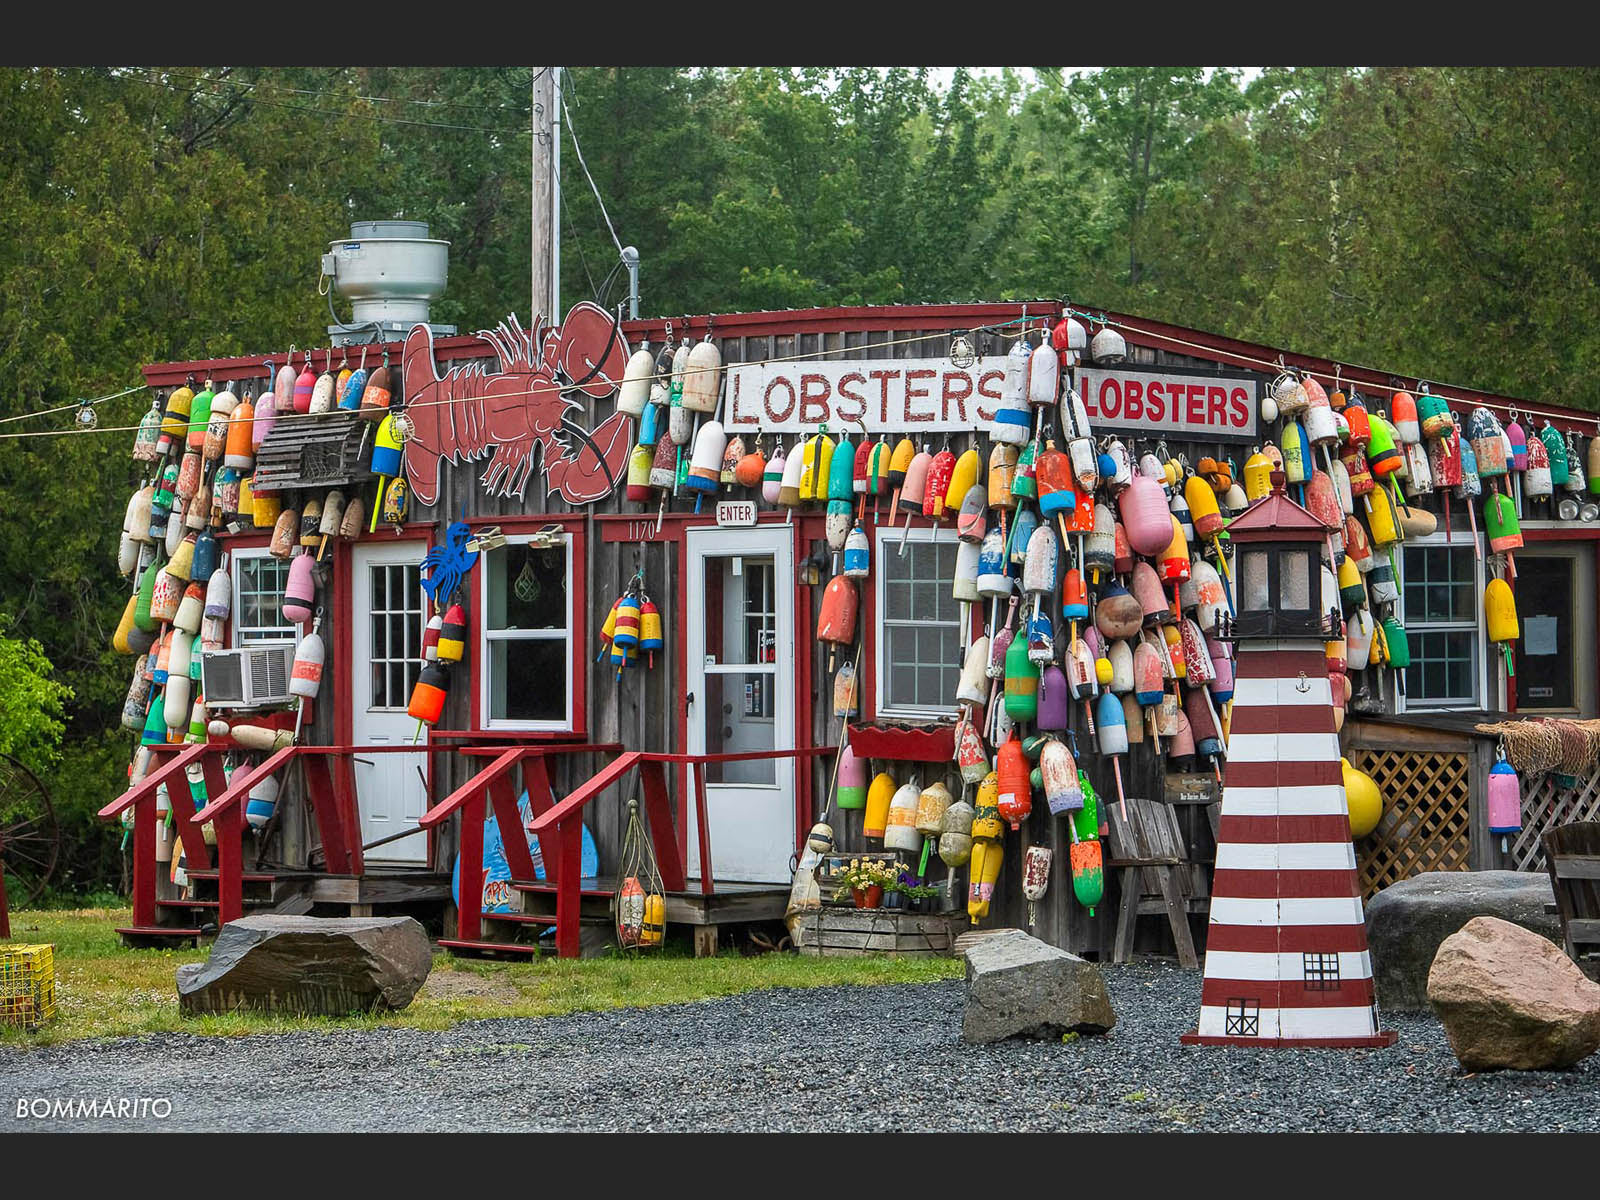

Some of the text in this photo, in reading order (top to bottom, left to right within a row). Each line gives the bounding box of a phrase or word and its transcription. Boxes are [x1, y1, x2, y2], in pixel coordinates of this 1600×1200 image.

[1081, 376, 1249, 428] LOBSTERS
[720, 506, 752, 521] ENTER
[629, 521, 655, 540] 1170
